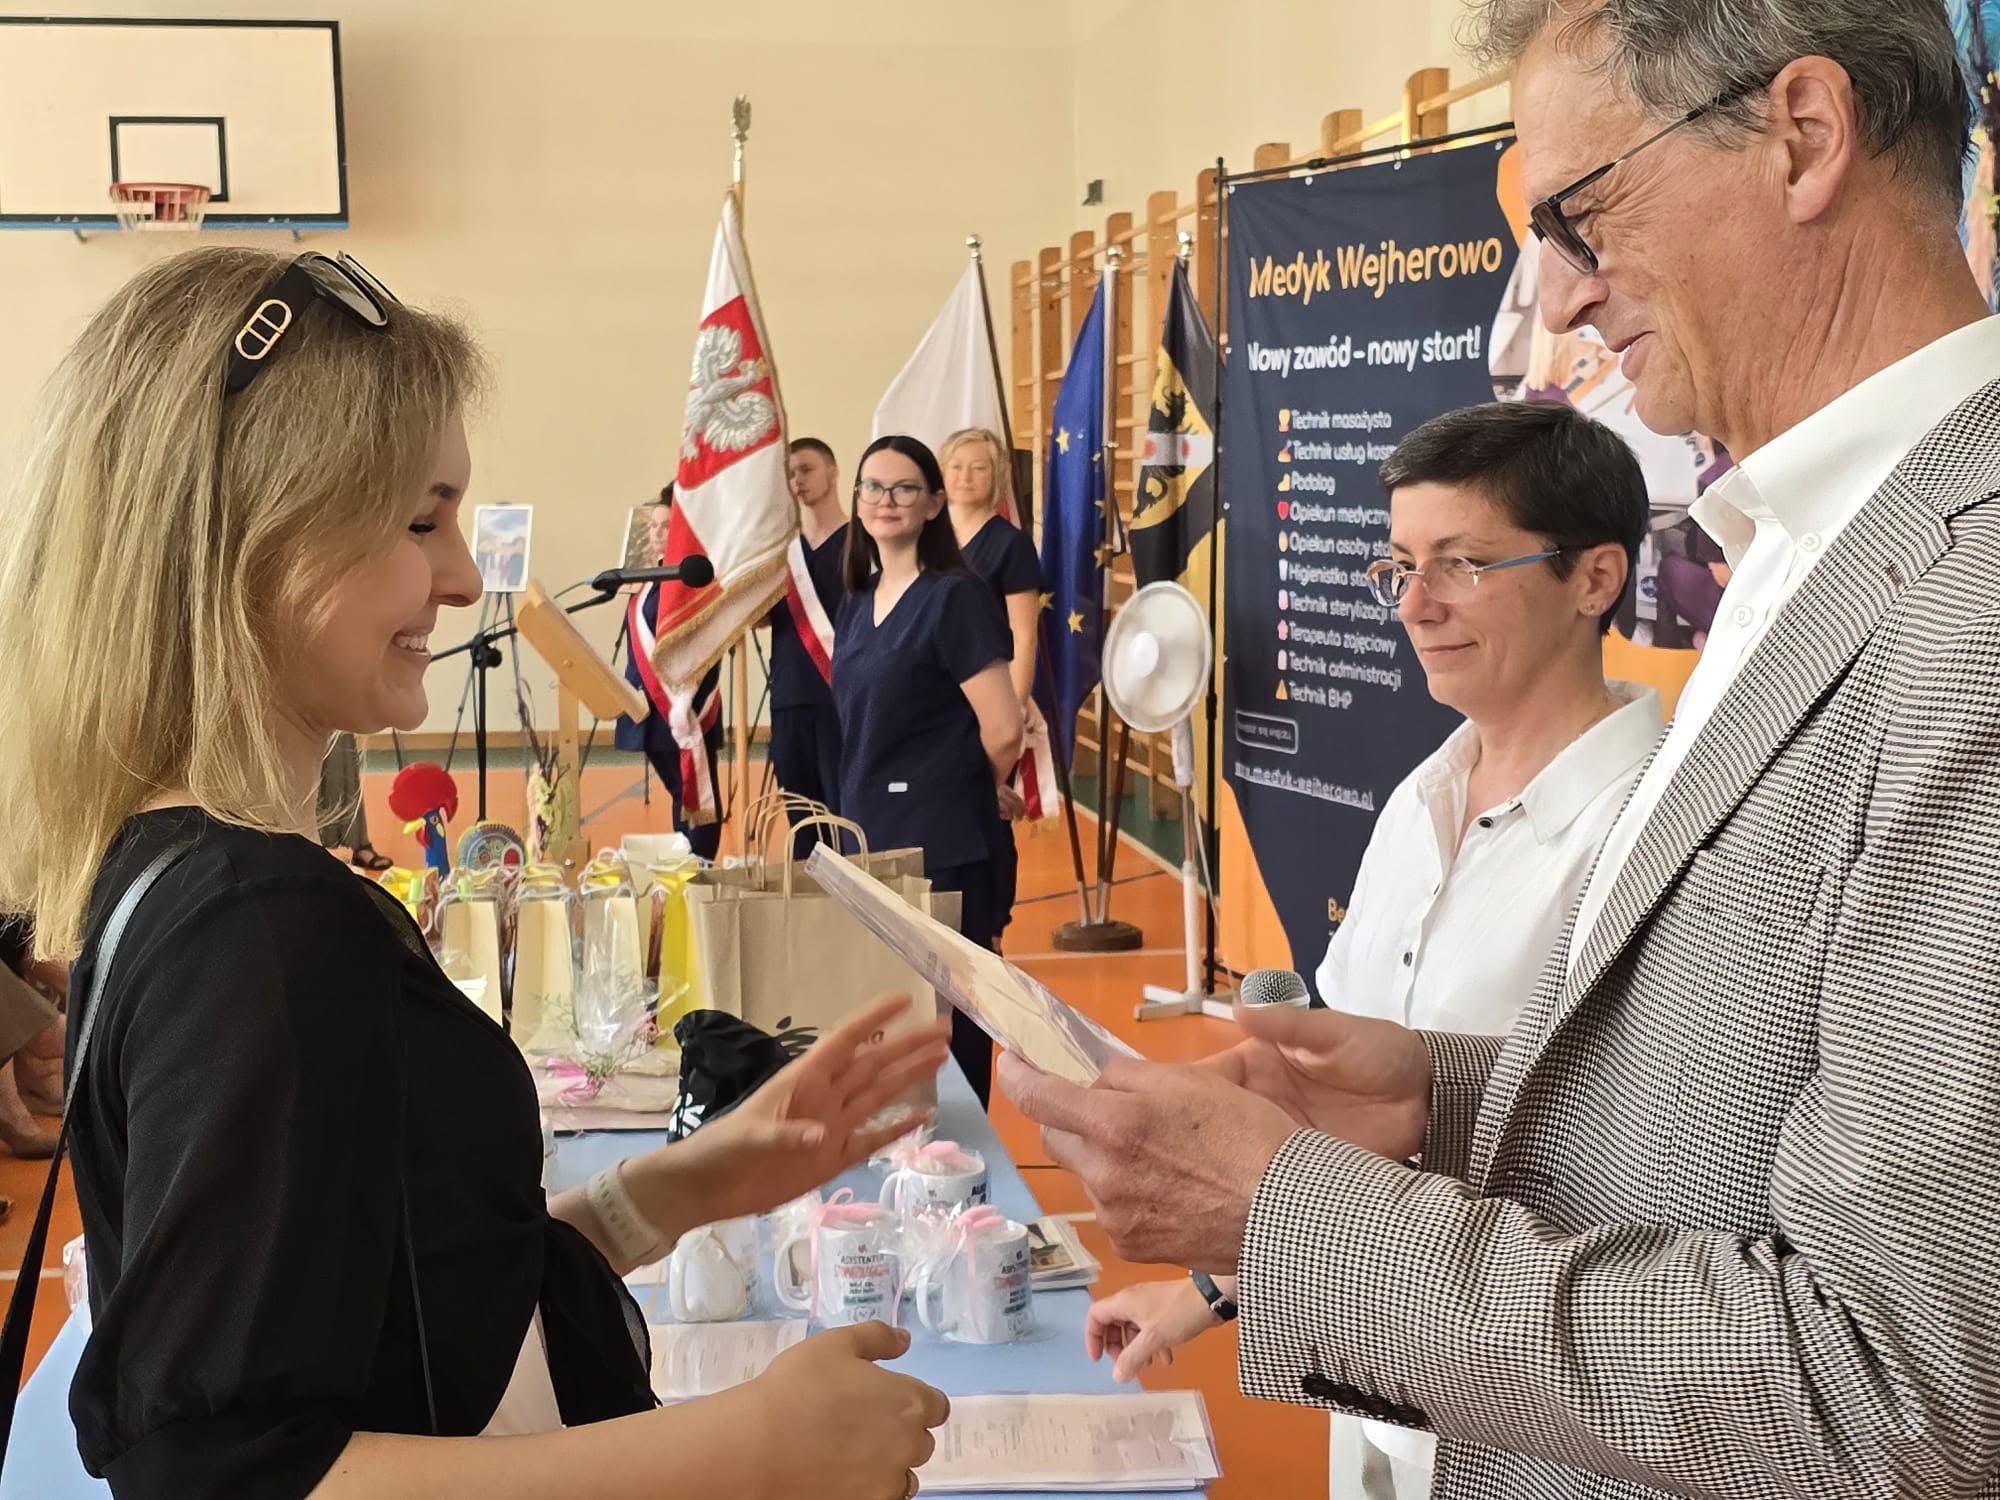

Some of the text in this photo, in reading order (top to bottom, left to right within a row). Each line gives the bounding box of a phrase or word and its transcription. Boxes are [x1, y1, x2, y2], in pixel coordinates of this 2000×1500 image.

[1249, 237, 1503, 306] Medyk Wejherowo
[1248, 341, 1291, 379] Nowy
[1293, 334, 1351, 370] zawód
[1367, 338, 1420, 373] nowy
[1422, 324, 1482, 363] start!
[1291, 409, 1393, 433] Technik masażysta
[1293, 440, 1333, 461] Technik
[1333, 442, 1366, 465] usług
[1291, 470, 1336, 496] Podolog
[1289, 500, 1336, 525] Opiekun
[1289, 530, 1336, 555] Opiekun
[1336, 536, 1371, 561] osoby
[1288, 562, 1349, 587] Higienistka
[1289, 591, 1329, 615] Technik
[1329, 598, 1389, 626] sterylizacji
[1289, 621, 1397, 660] Terapeuta zajęciowy
[1289, 651, 1402, 693] Technik administracji
[1289, 681, 1353, 710] Technik BHP
